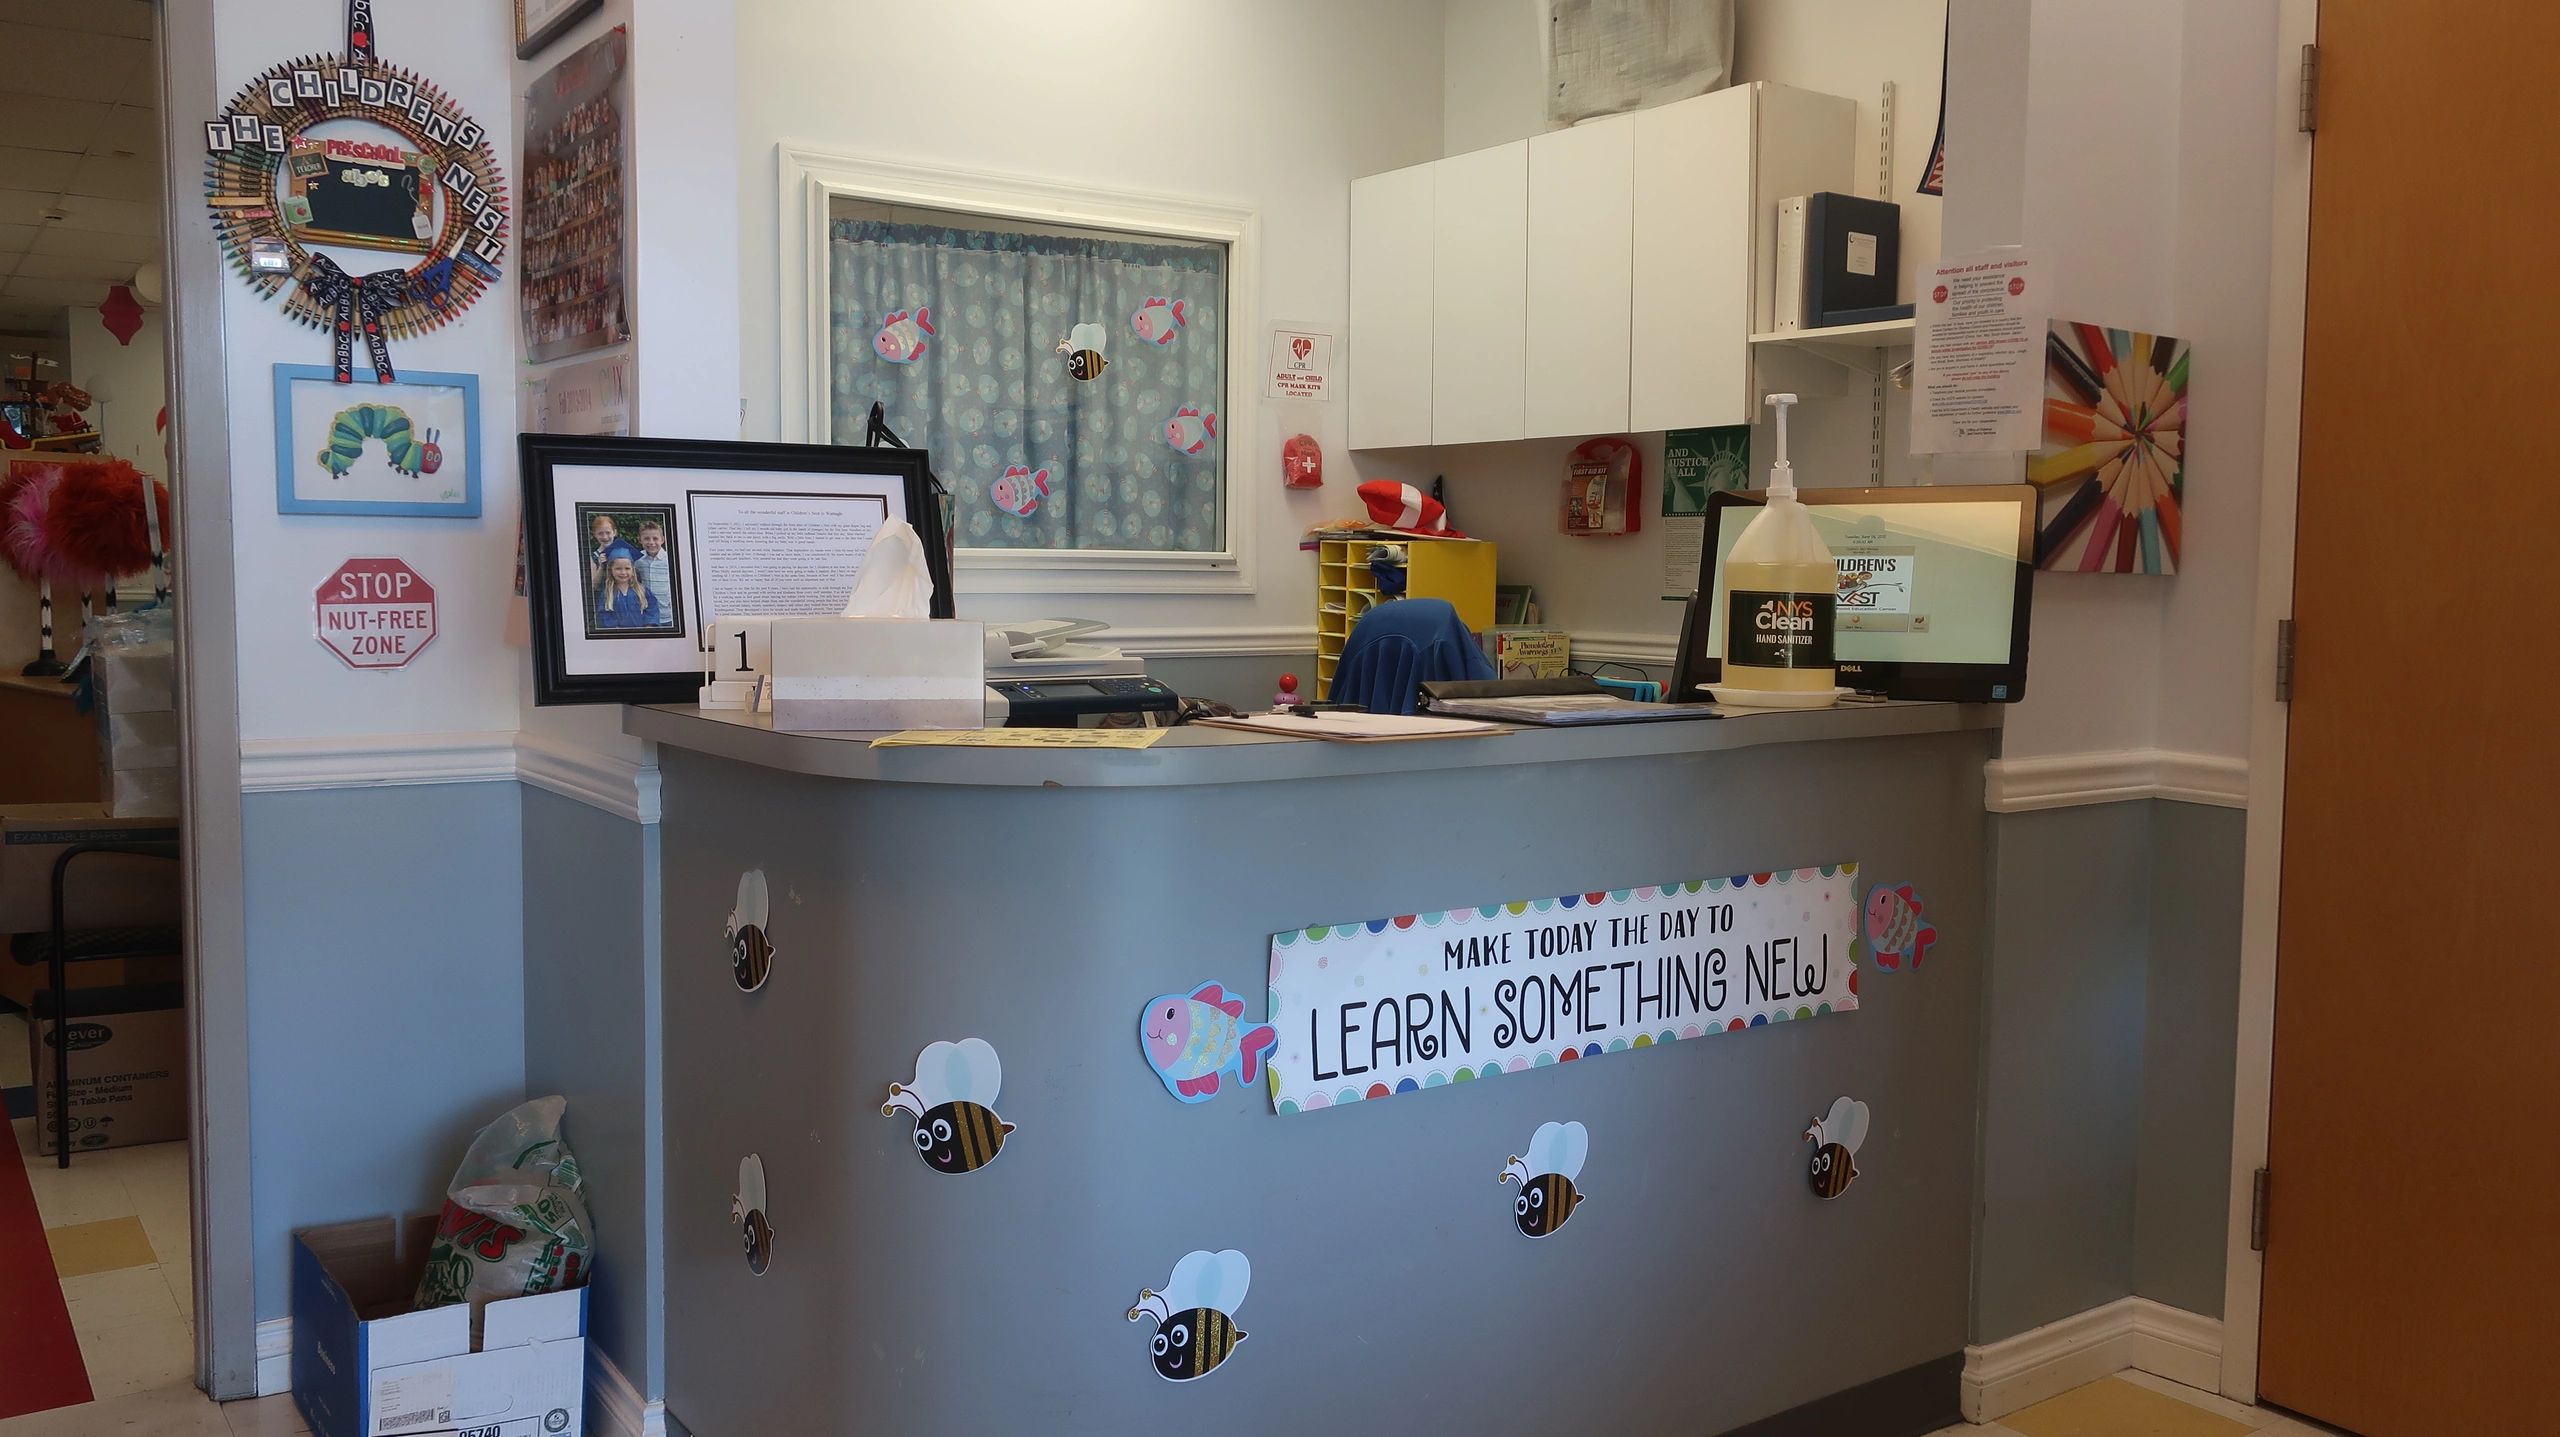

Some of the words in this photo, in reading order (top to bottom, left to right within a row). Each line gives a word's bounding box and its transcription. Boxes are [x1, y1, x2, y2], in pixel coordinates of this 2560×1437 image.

[209, 117, 281, 149] THE
[271, 71, 479, 148] CHILDRENS
[447, 167, 500, 257] NEST
[1936, 268, 1964, 276] Attention
[1990, 262, 2002, 270] and
[2003, 260, 2028, 268] visitors
[1668, 448, 1689, 458] AND
[1669, 457, 1709, 467] JUSTICE
[1678, 467, 1697, 477] ALL
[340, 573, 412, 599] STOP
[1777, 600, 1813, 617] NYS
[328, 610, 428, 631] NUT-FREE
[1755, 611, 1814, 631] Clean
[352, 635, 407, 655] ZONE
[1756, 634, 1777, 644] HAND
[1777, 635, 1813, 645] SANITIZER
[734, 631, 754, 672] 1
[14, 833, 48, 842] EXAM
[52, 832, 87, 841] TABLE
[90, 831, 129, 841] PAPER
[1443, 931, 1512, 972] MAKE
[1524, 920, 1598, 960] TODAY
[1608, 914, 1649, 948] THE
[1660, 907, 1700, 940] DAY
[1708, 904, 1734, 933] TO
[1310, 985, 1472, 1082] LEARN
[1493, 947, 1727, 1049] SOMETHING
[1744, 934, 1829, 1004] NEW
[104, 1070, 169, 1084] CONTAINERS
[95, 1085, 133, 1094] Medium
[80, 1097, 107, 1105] Table
[109, 1094, 133, 1103] Pans
